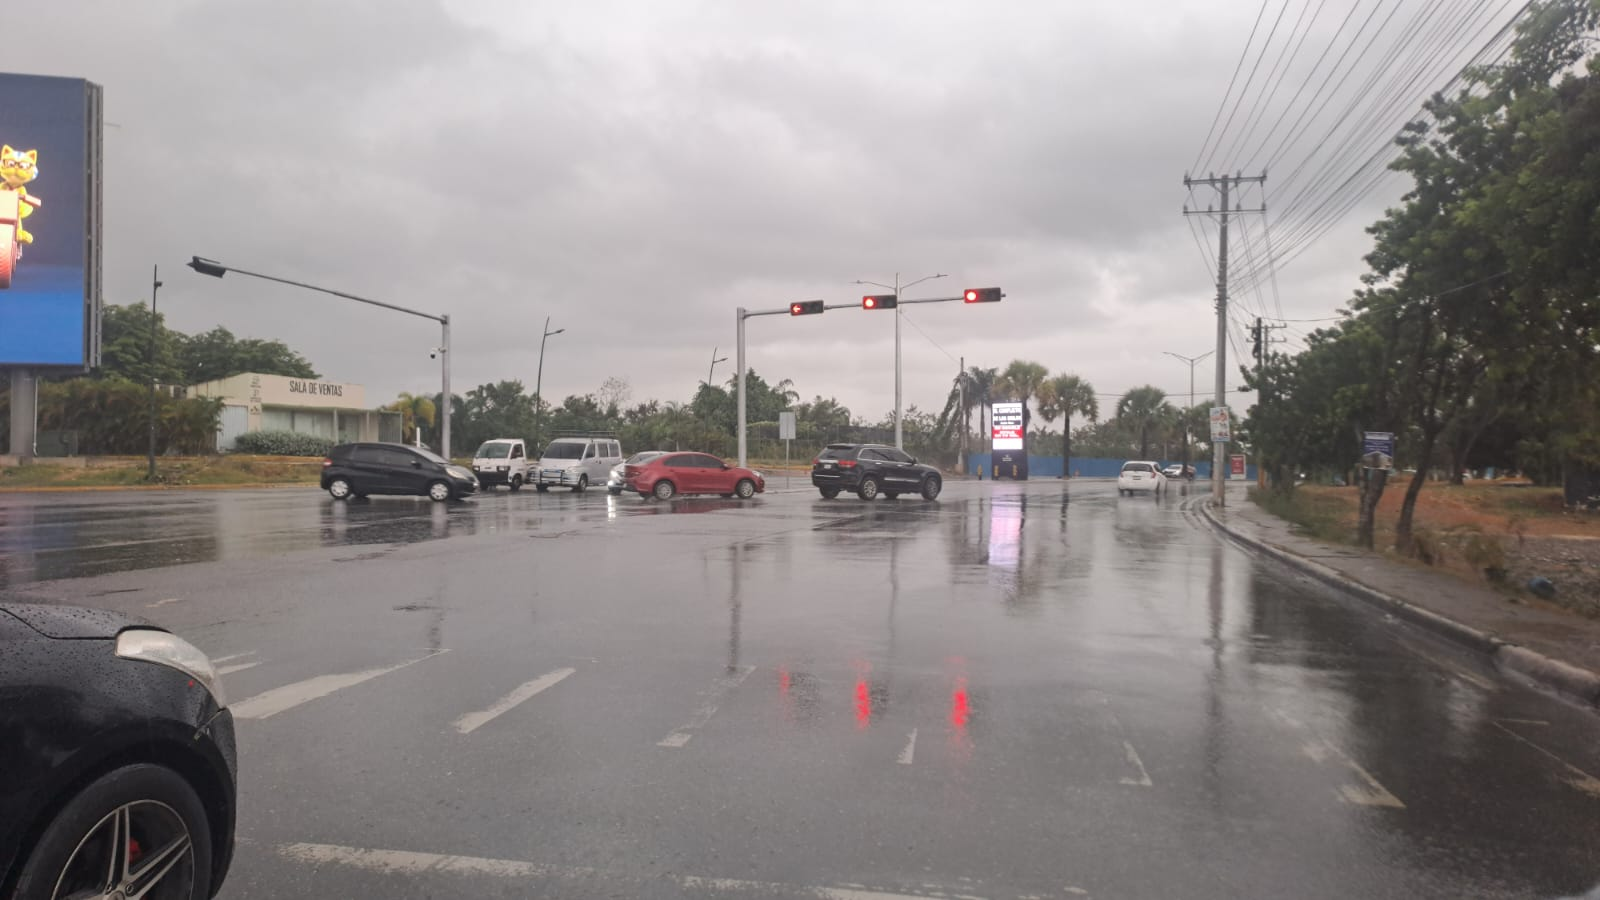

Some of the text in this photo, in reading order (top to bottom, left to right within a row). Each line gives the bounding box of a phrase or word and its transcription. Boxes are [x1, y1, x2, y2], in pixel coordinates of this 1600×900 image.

[289, 380, 343, 397] SALA DE VENTAS
